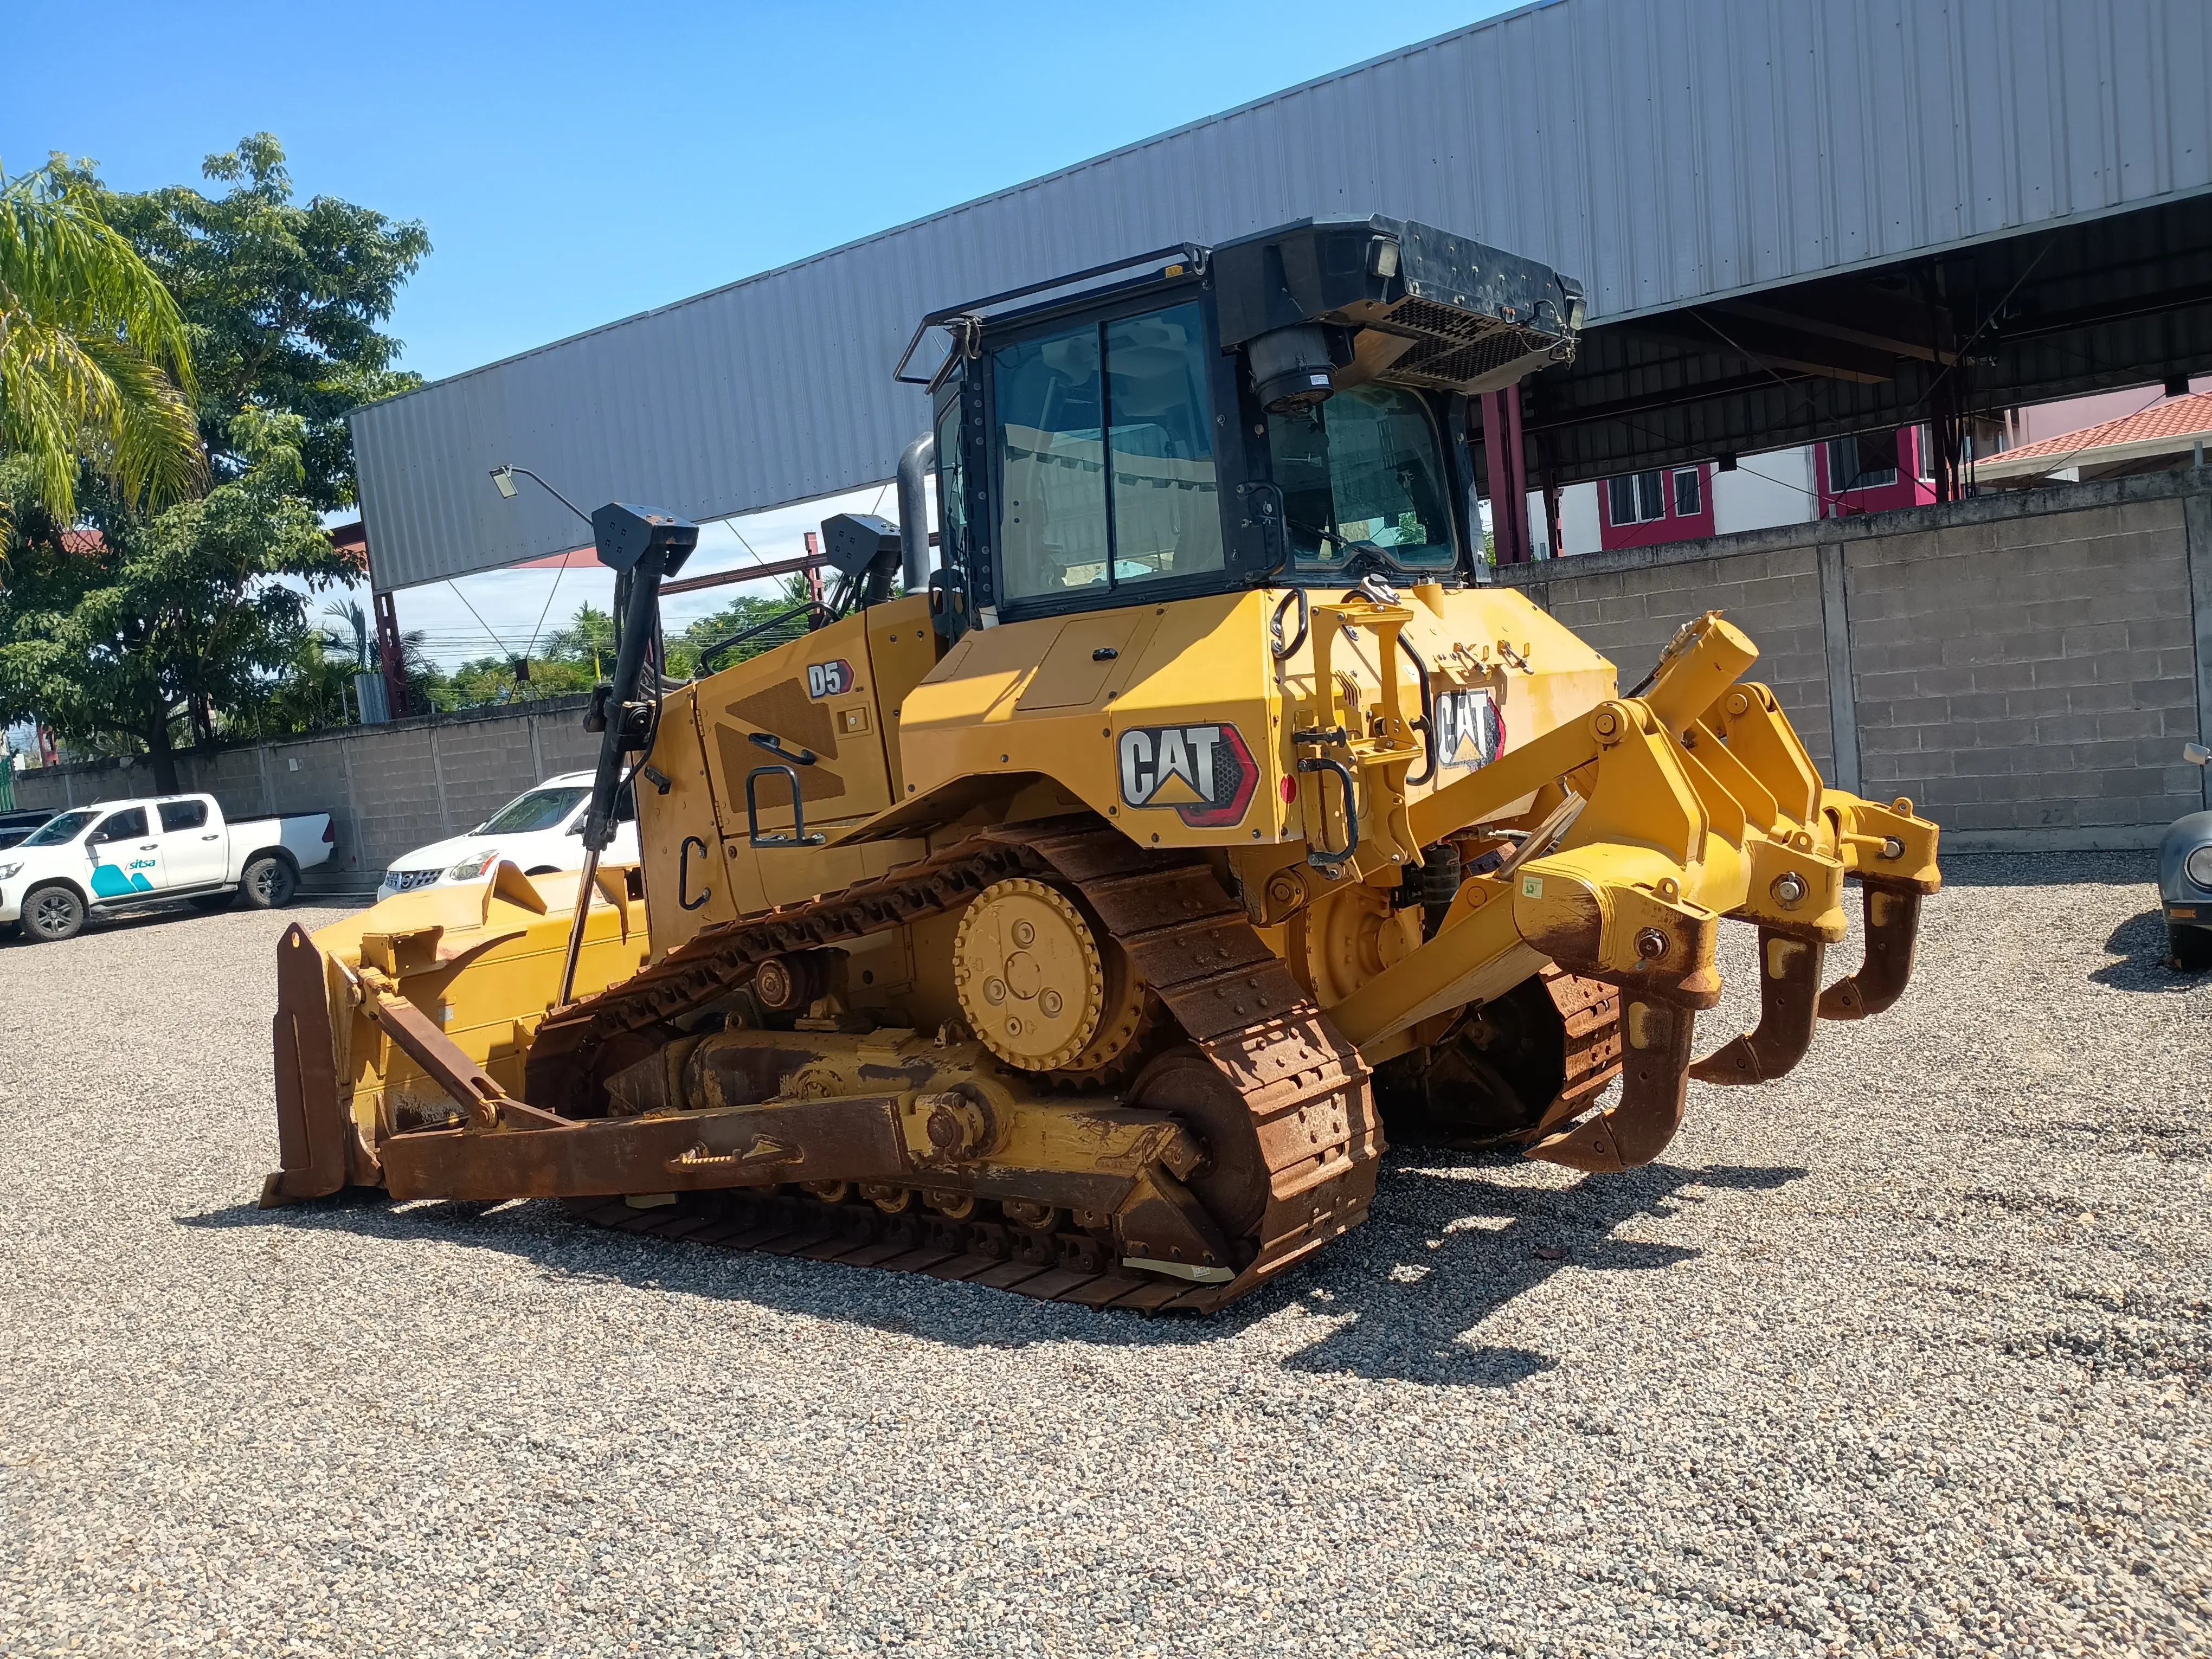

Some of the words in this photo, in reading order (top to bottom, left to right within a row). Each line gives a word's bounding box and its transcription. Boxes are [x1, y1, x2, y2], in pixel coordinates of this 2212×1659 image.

[808, 662, 841, 697] D5
[1436, 693, 1488, 763] CAT
[1121, 726, 1220, 805] CAT
[129, 859, 156, 870] sitsa
